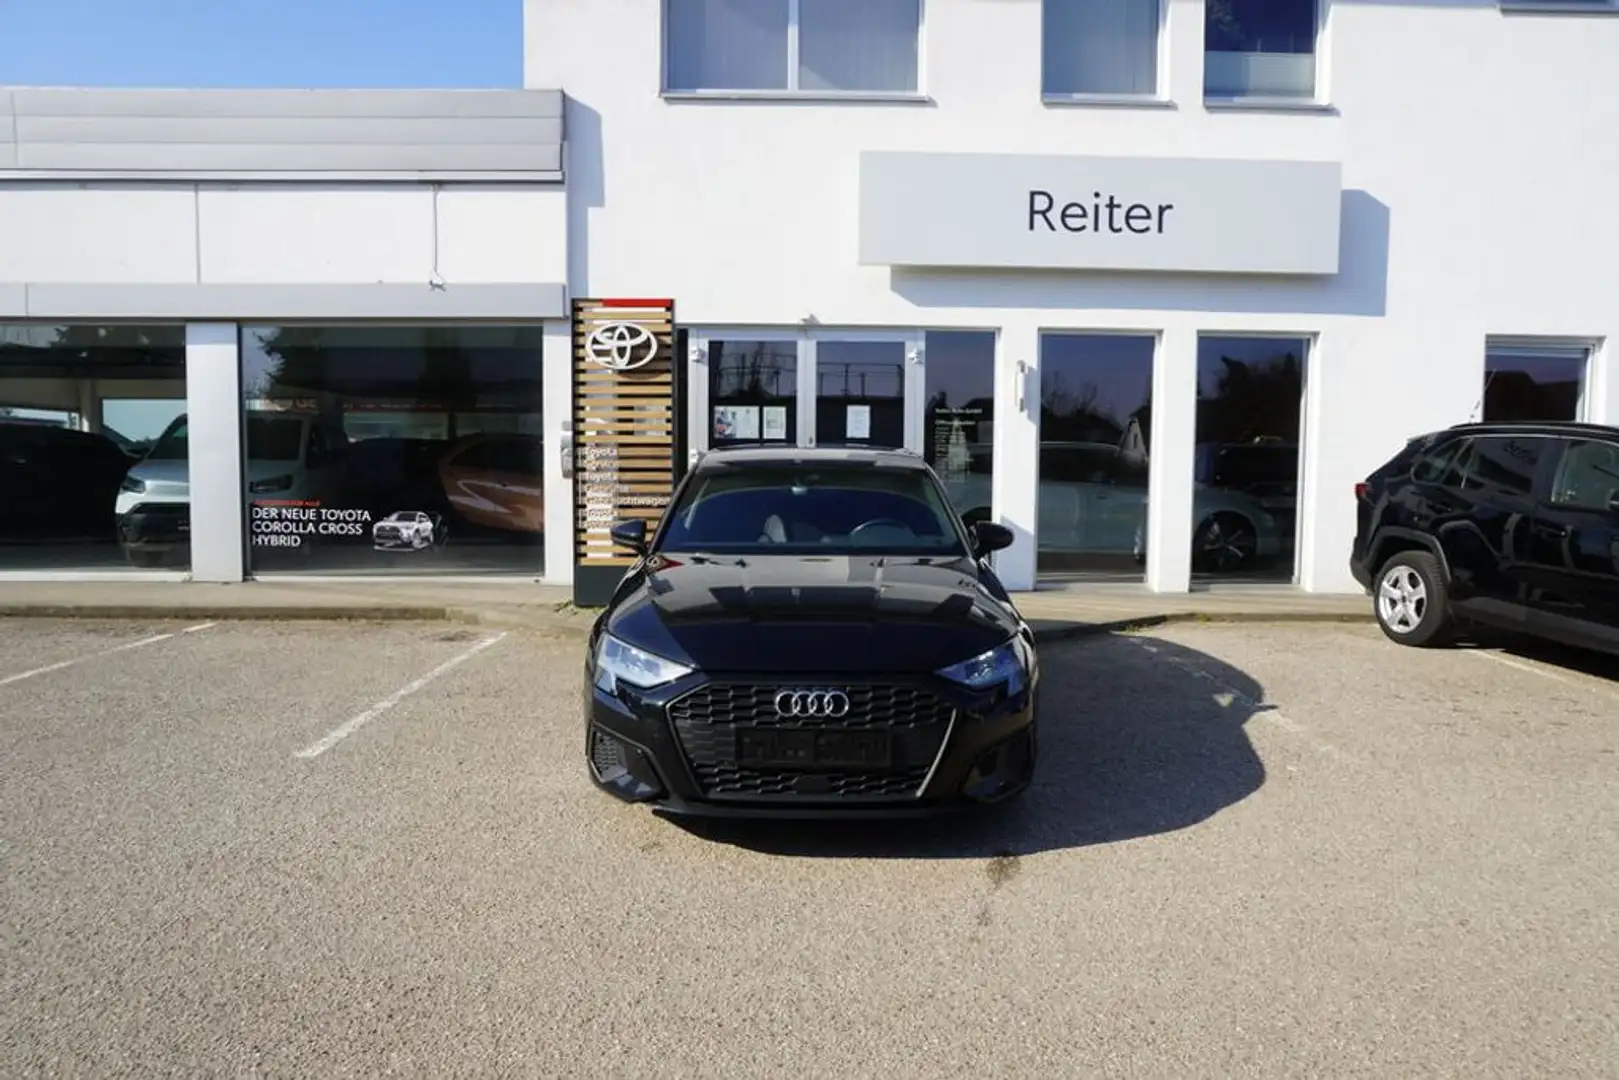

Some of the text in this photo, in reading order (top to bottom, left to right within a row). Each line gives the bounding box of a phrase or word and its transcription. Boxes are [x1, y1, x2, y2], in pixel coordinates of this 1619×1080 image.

[1028, 190, 1174, 234] Reiter
[252, 507, 371, 521] DER NEUE TOYOTA
[252, 521, 363, 535] COROLLA CROSS
[252, 535, 301, 547] HYBRID
